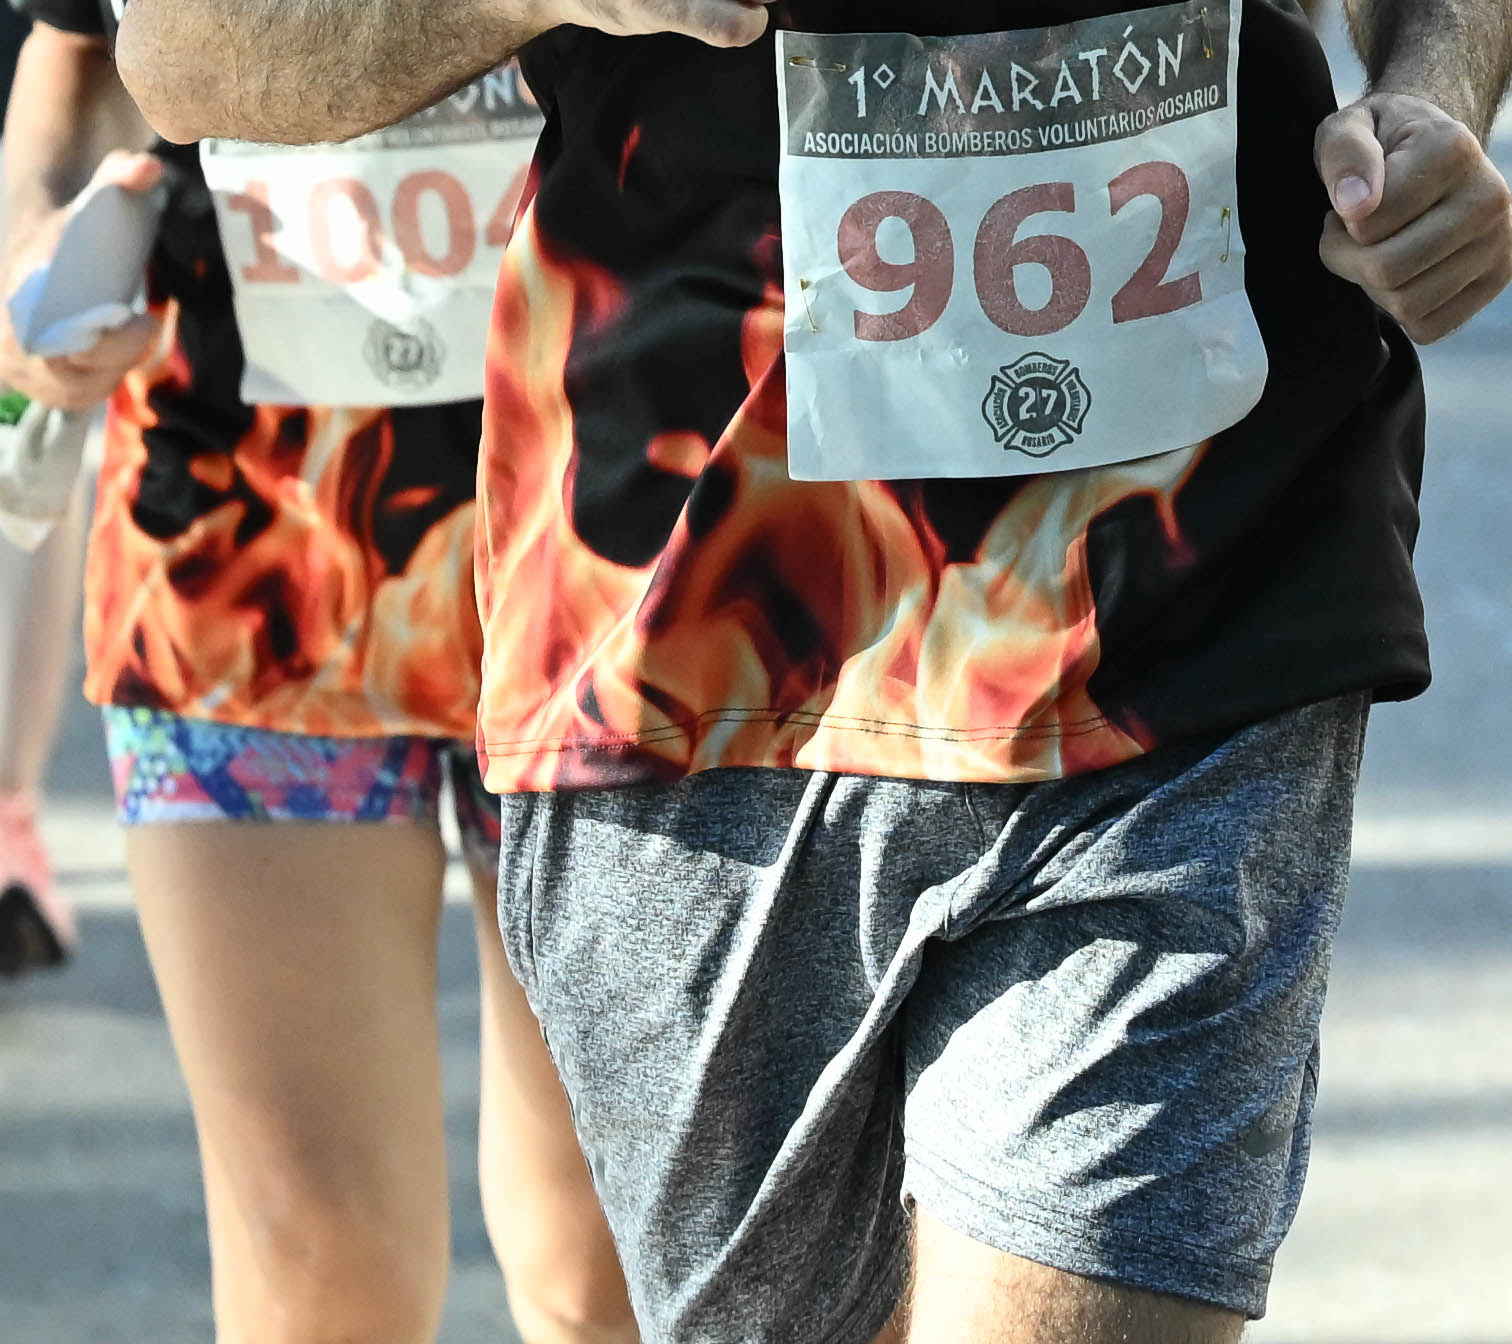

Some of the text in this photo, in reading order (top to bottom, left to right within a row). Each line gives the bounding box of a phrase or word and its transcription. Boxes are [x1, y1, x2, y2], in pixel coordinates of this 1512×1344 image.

[917, 25, 1185, 117] MARATÓN
[804, 84, 1220, 154] ASOCIACIÓN BOMBEROS VOLUNTARIOS ROSARIO
[836, 159, 1204, 343] 962
[1018, 386, 1057, 421] 27
